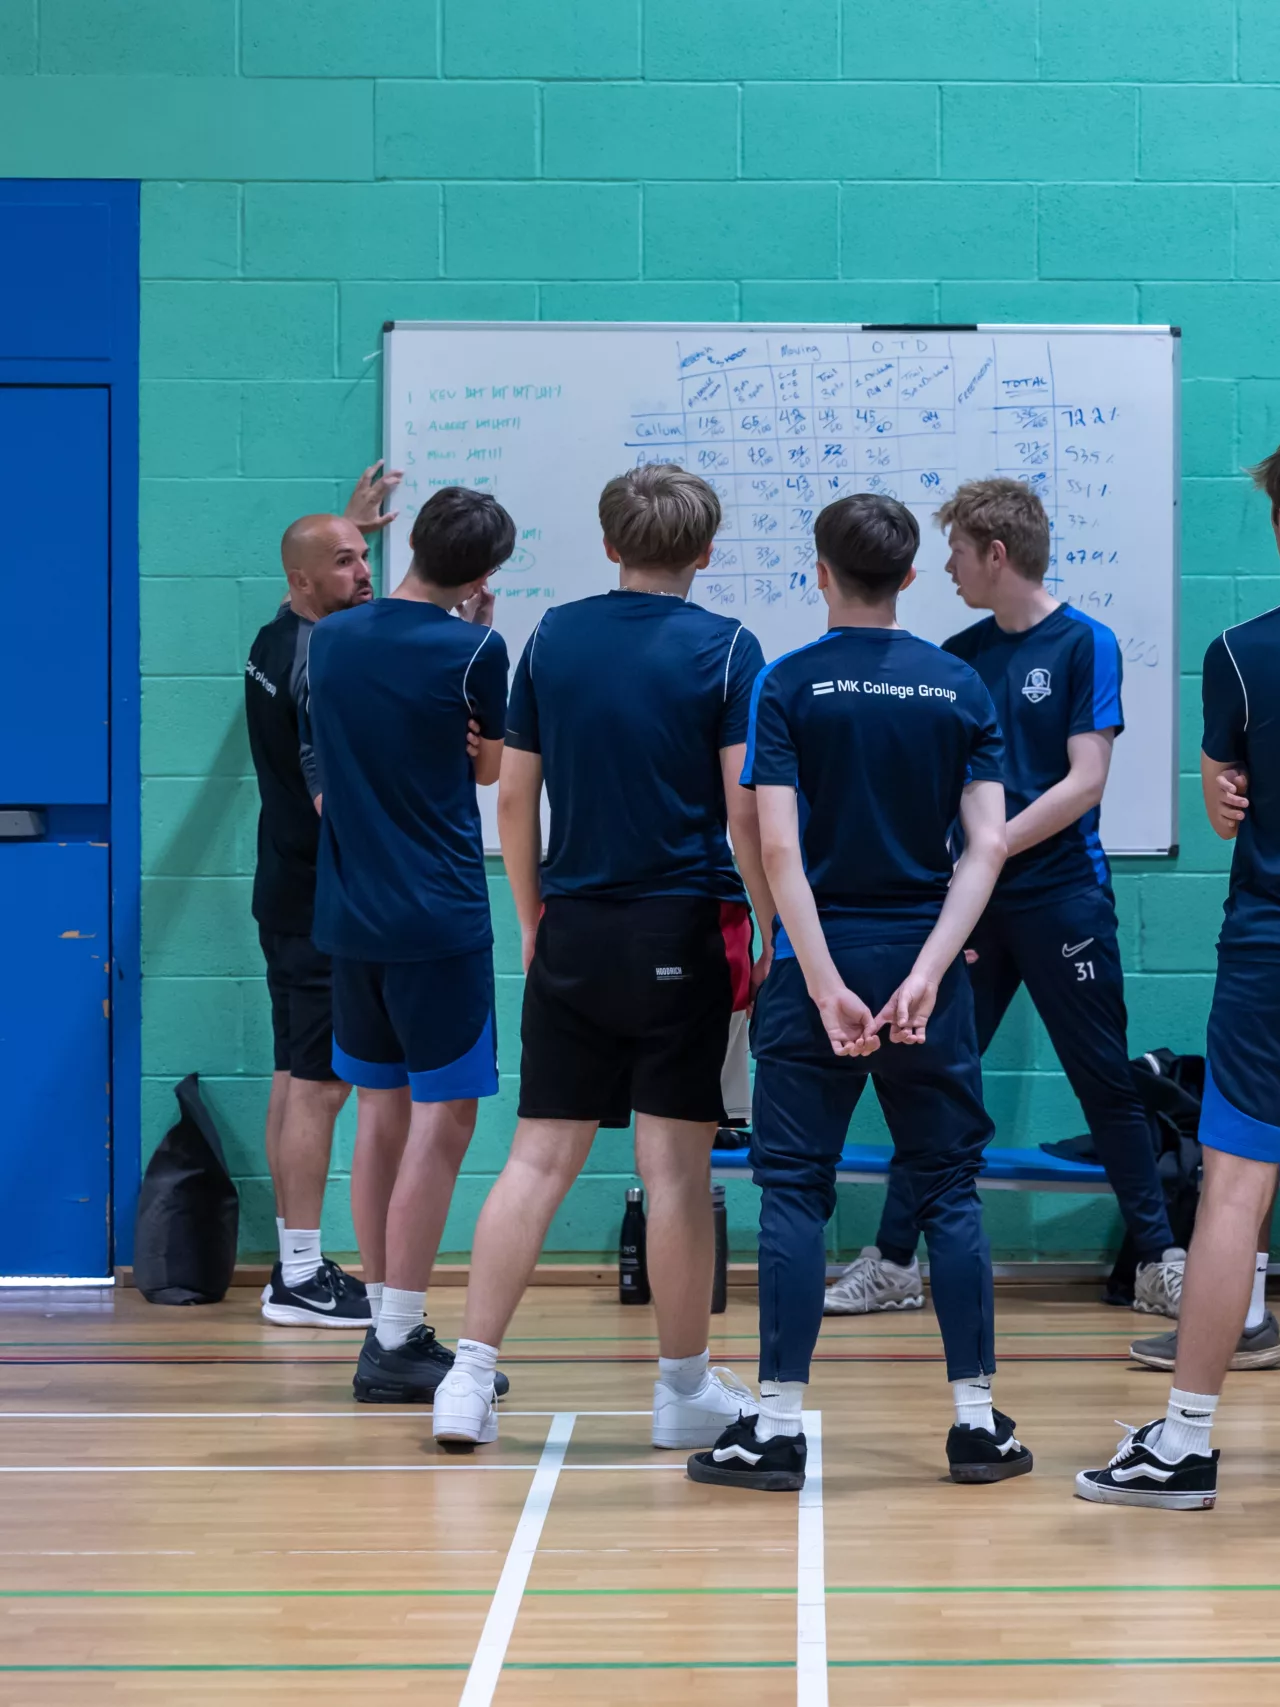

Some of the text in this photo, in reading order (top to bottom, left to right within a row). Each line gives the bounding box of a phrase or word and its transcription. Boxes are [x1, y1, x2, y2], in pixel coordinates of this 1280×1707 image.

[1002, 376, 1049, 389] TOTAL
[635, 422, 684, 438] Callum
[837, 680, 957, 702] MK College Group
[1074, 960, 1096, 981] 31
